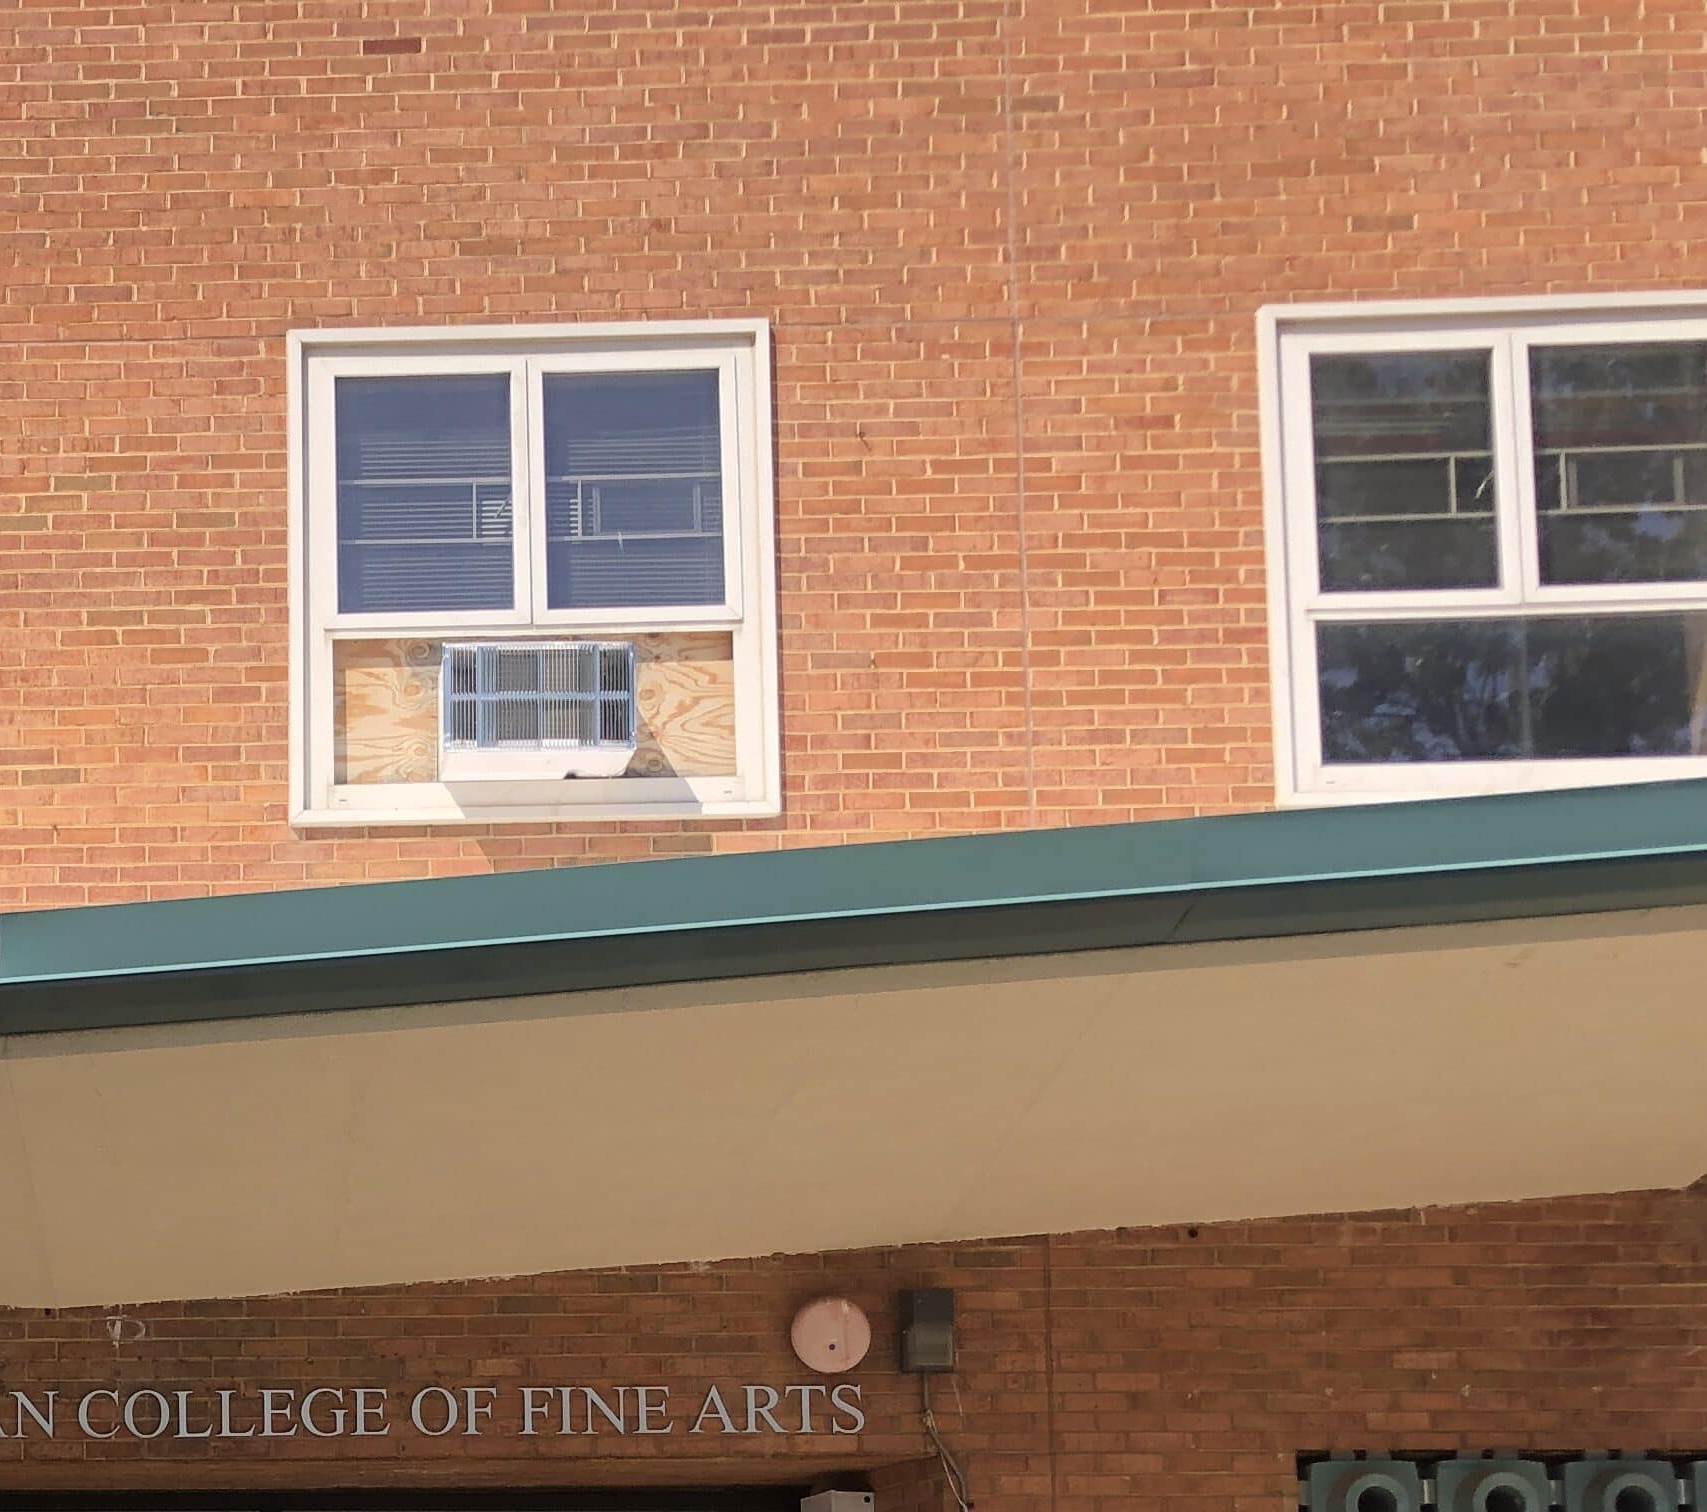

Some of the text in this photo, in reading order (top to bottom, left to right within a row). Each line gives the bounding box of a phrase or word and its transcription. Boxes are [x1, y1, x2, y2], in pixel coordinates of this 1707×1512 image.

[77, 1389, 391, 1439] COLLEGE
[411, 1387, 497, 1436] OF
[518, 1386, 674, 1435] FINE
[688, 1384, 866, 1434] ARTS
